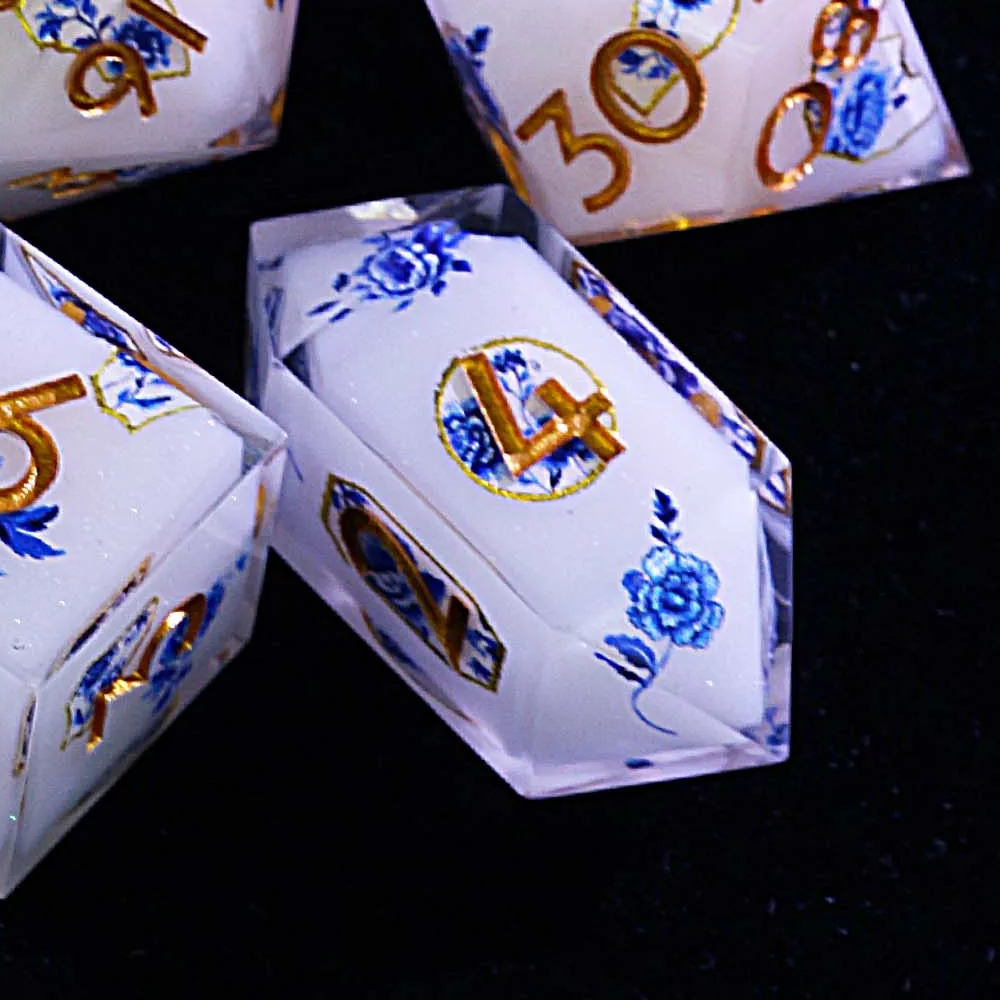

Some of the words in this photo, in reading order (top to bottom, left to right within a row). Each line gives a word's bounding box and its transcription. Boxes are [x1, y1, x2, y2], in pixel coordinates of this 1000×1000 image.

[514, 27, 707, 213] 30
[457, 352, 628, 479] 4
[339, 506, 471, 673] 2
